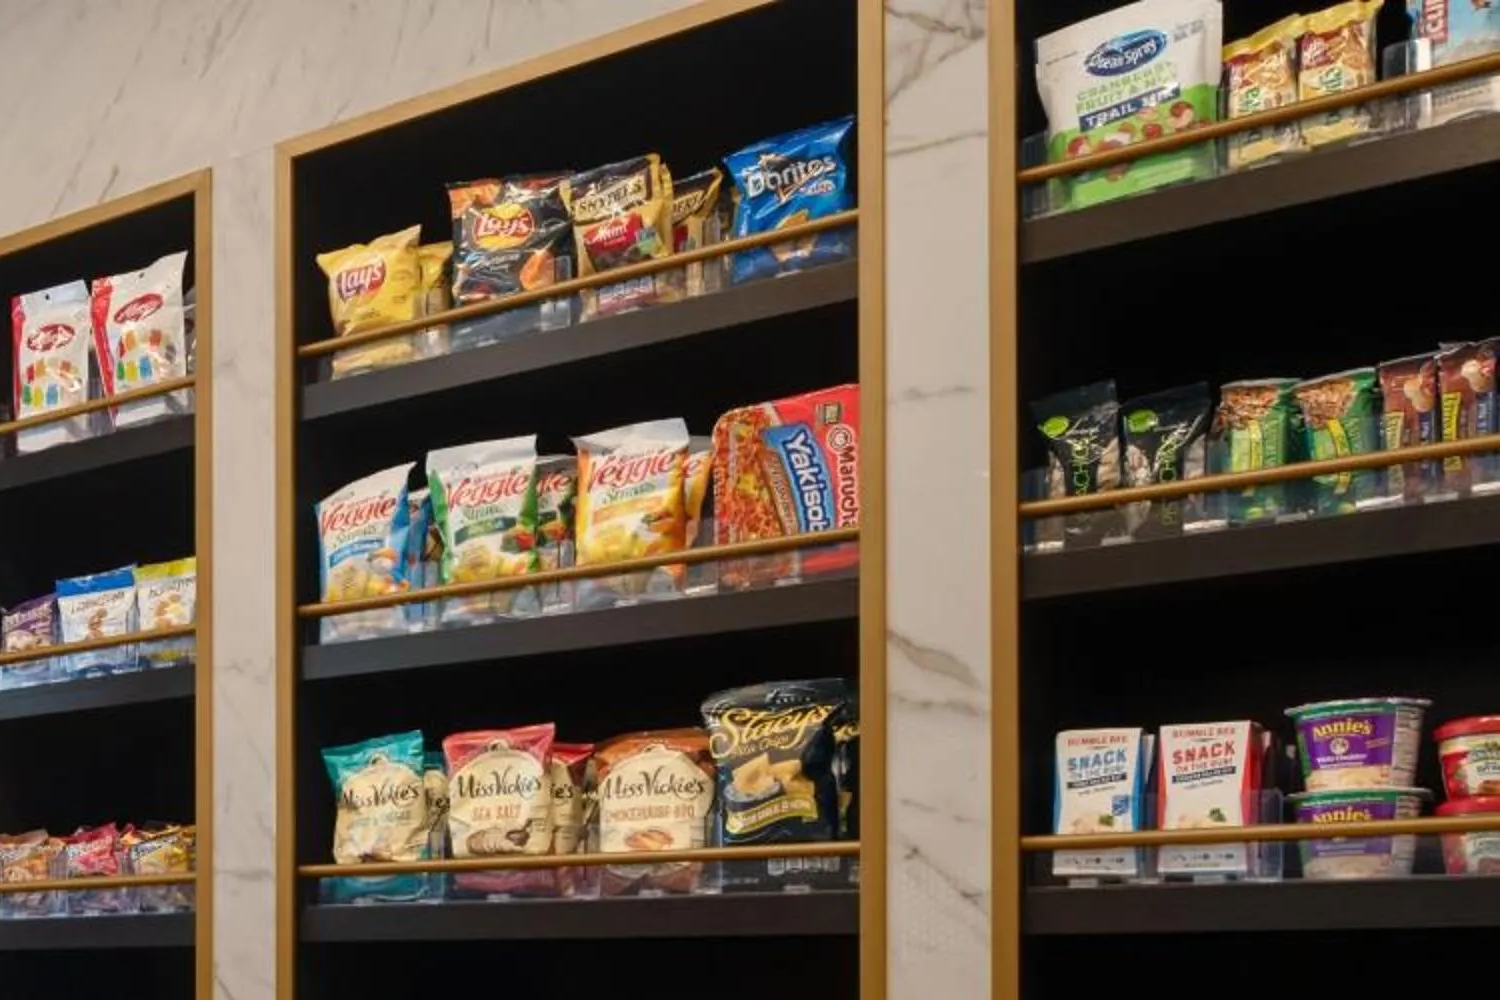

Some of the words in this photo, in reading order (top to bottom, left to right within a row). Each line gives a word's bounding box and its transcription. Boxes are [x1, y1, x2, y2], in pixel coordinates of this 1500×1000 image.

[743, 156, 837, 198] Doritos
[477, 211, 530, 237] Lay's
[340, 263, 385, 297] Lay's
[591, 452, 676, 492] Veggie
[784, 431, 831, 532] Yakisob
[839, 446, 859, 529] Marucha
[446, 472, 530, 512] Veggie
[322, 496, 398, 532] Veggie
[709, 704, 836, 758] Stacy's
[1312, 718, 1373, 741] Annie's
[1067, 749, 1128, 772] SNACK
[1172, 741, 1236, 765] SNACK
